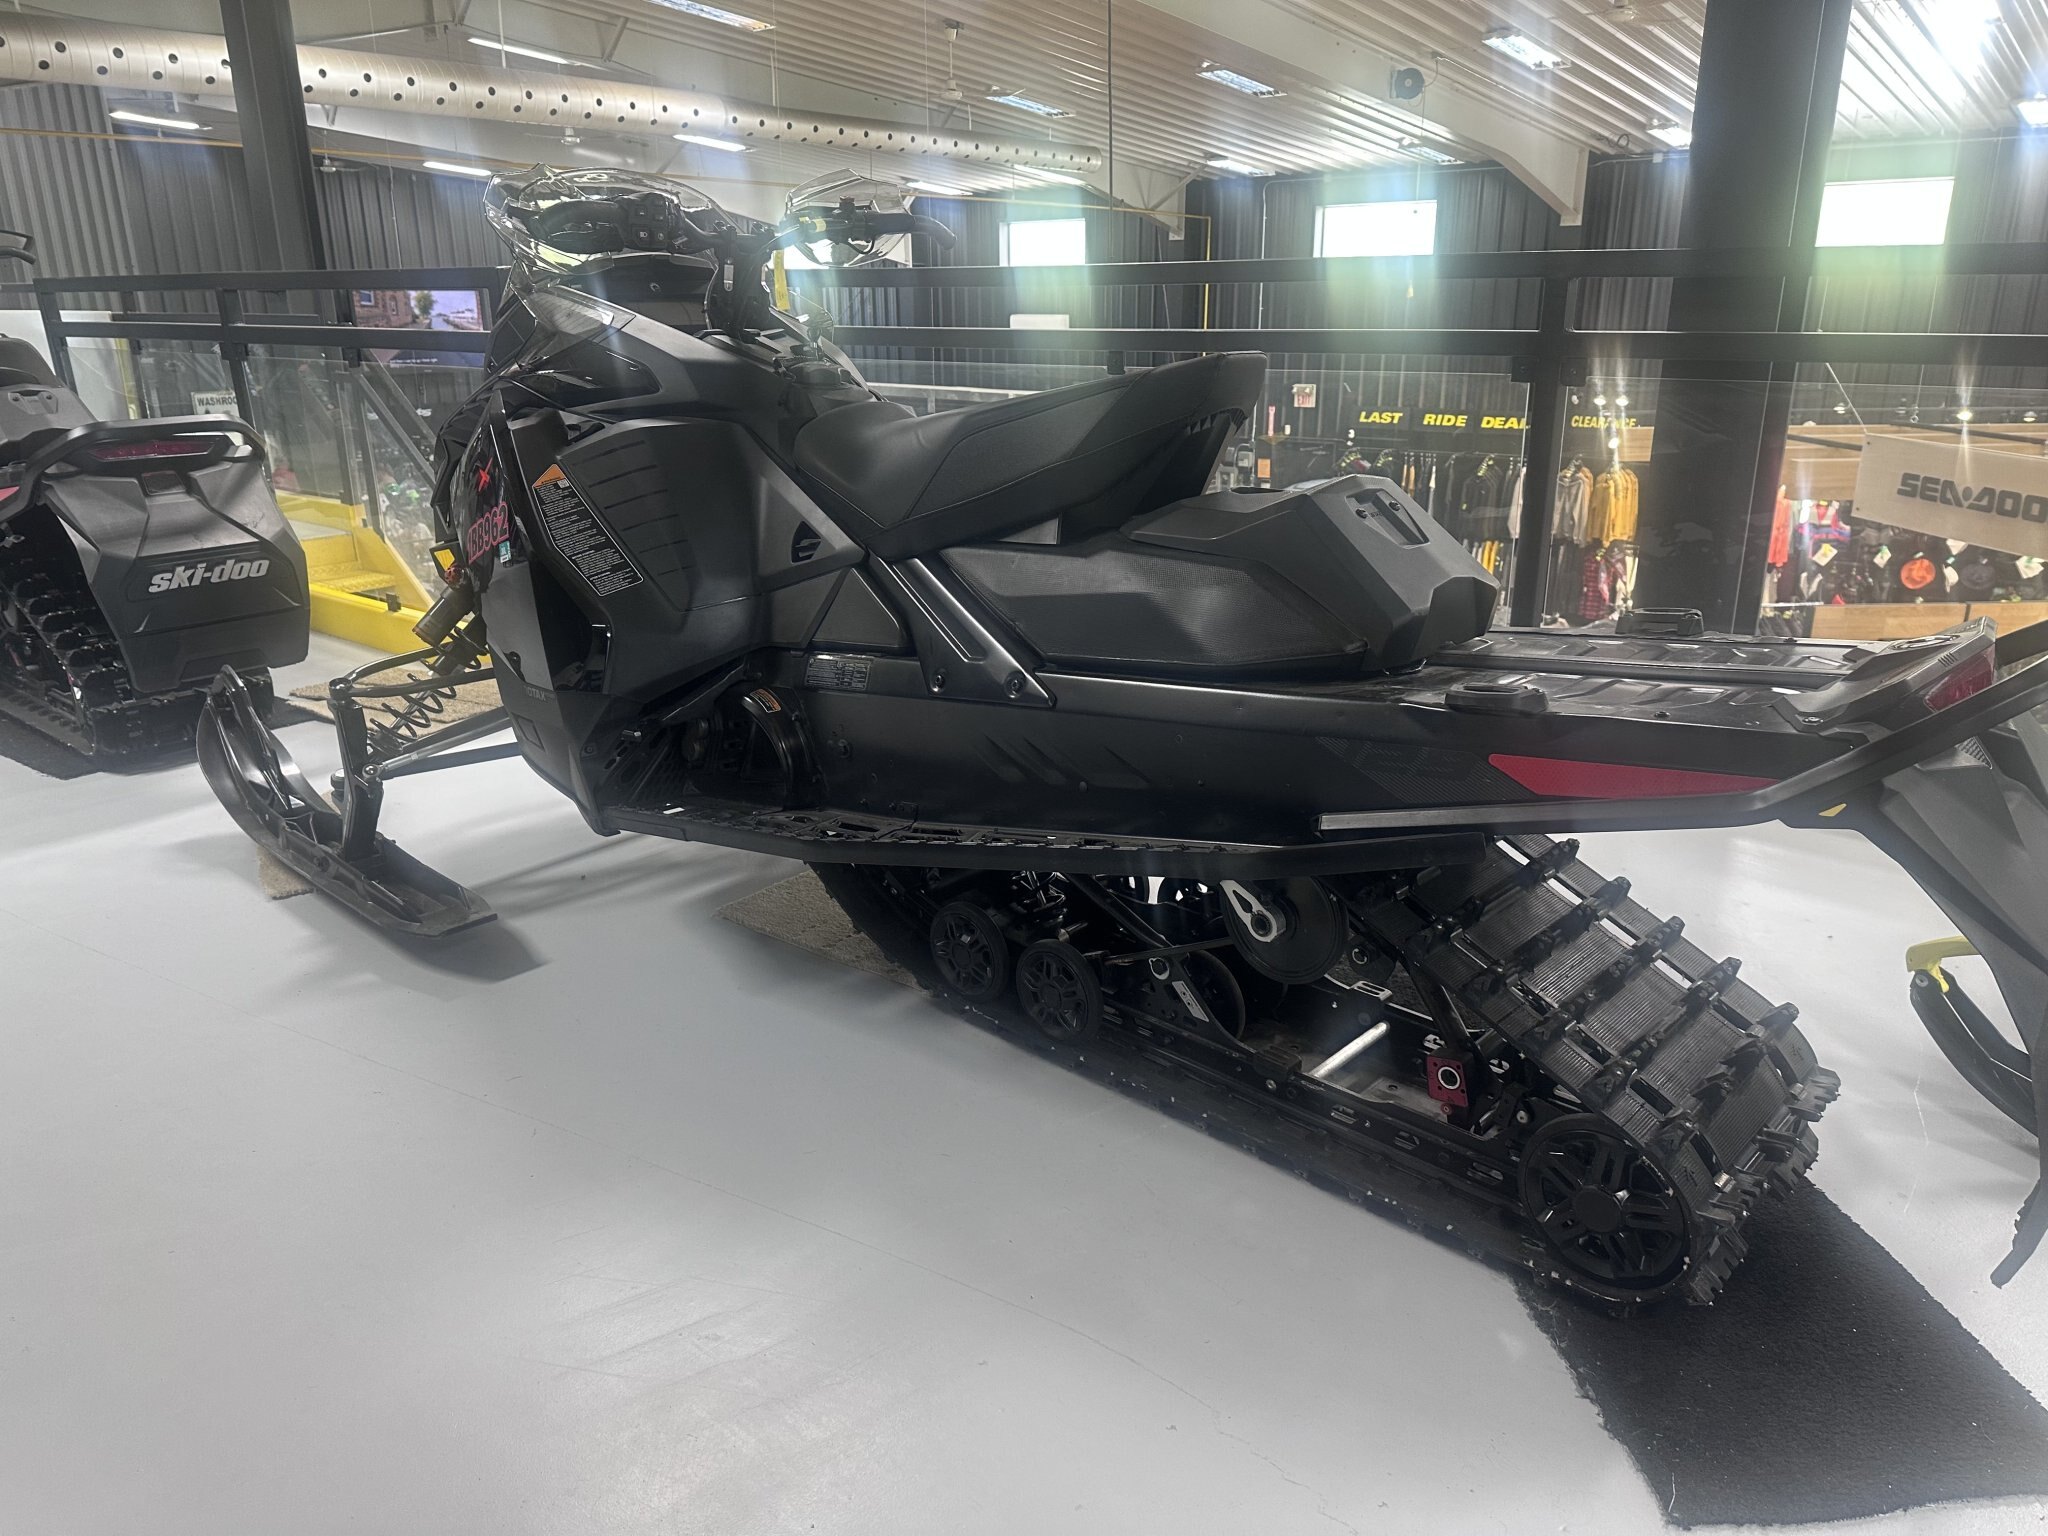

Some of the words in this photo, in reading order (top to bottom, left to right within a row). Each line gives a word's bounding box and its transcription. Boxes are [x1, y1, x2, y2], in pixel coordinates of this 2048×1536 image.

[196, 396, 238, 407] WASHROO
[1359, 411, 1404, 424] LAST
[1423, 413, 1468, 427] RIDE
[148, 559, 270, 593] ski-doo
